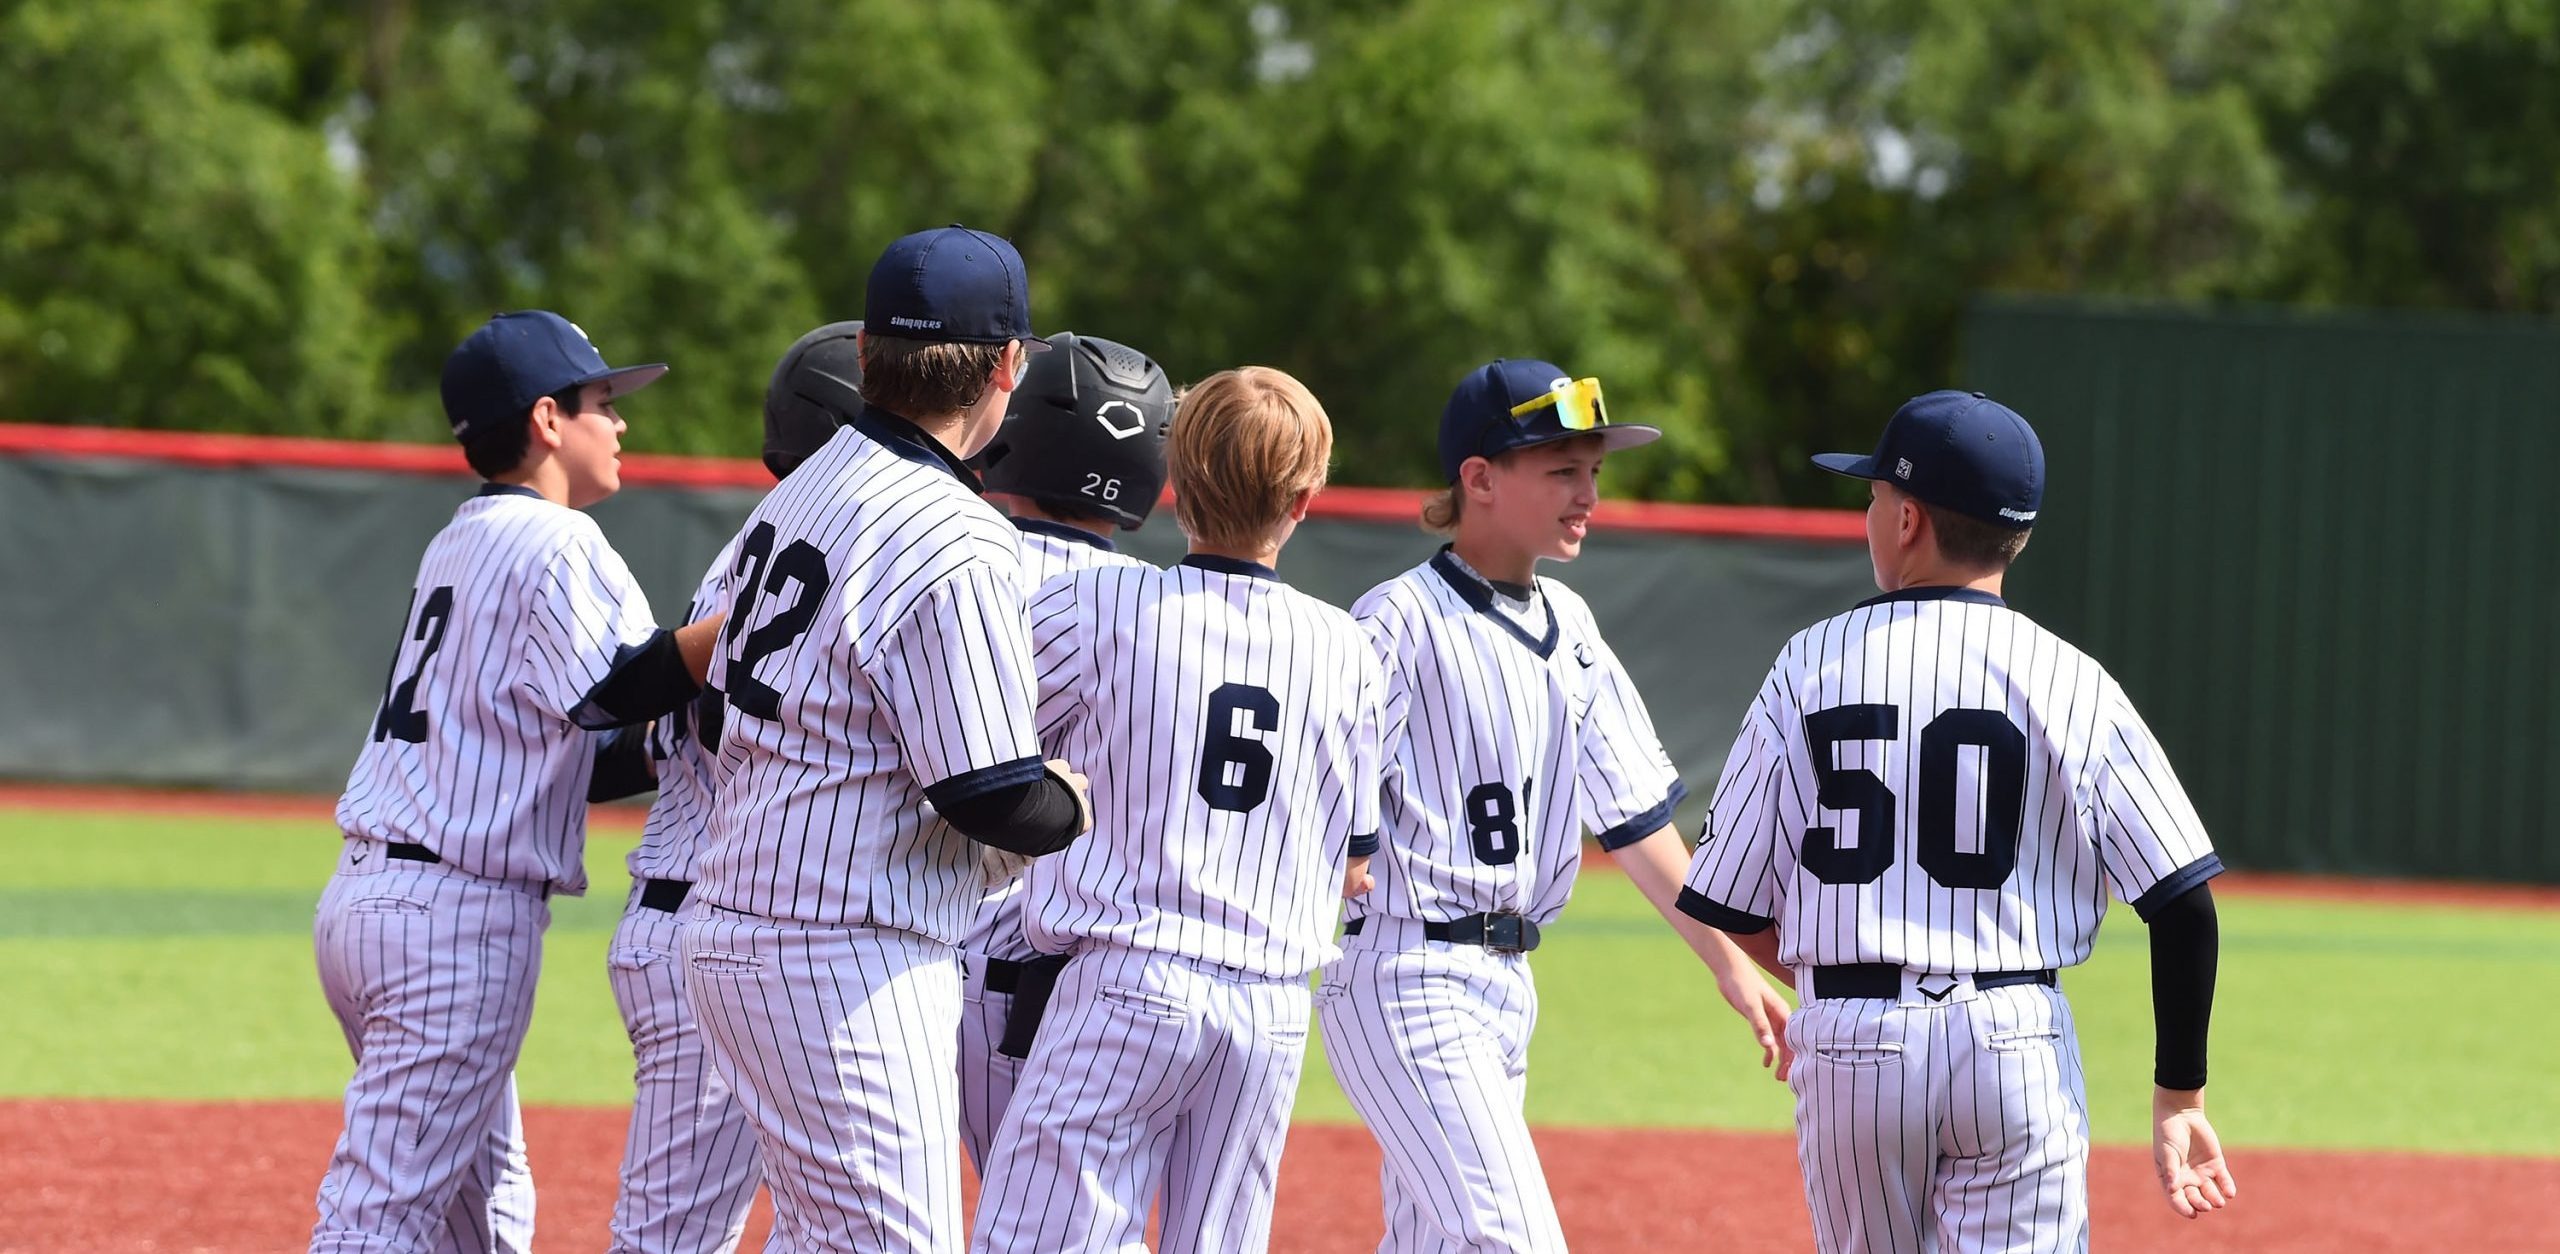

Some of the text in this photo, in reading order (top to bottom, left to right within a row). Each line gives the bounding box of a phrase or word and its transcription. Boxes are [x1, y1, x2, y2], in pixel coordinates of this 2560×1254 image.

[1080, 472, 1122, 501] 26
[374, 585, 454, 744] 12
[726, 520, 830, 722] 22
[1197, 681, 1280, 814] 6
[1800, 703, 2027, 891] 50
[1465, 775, 1533, 867] 8
